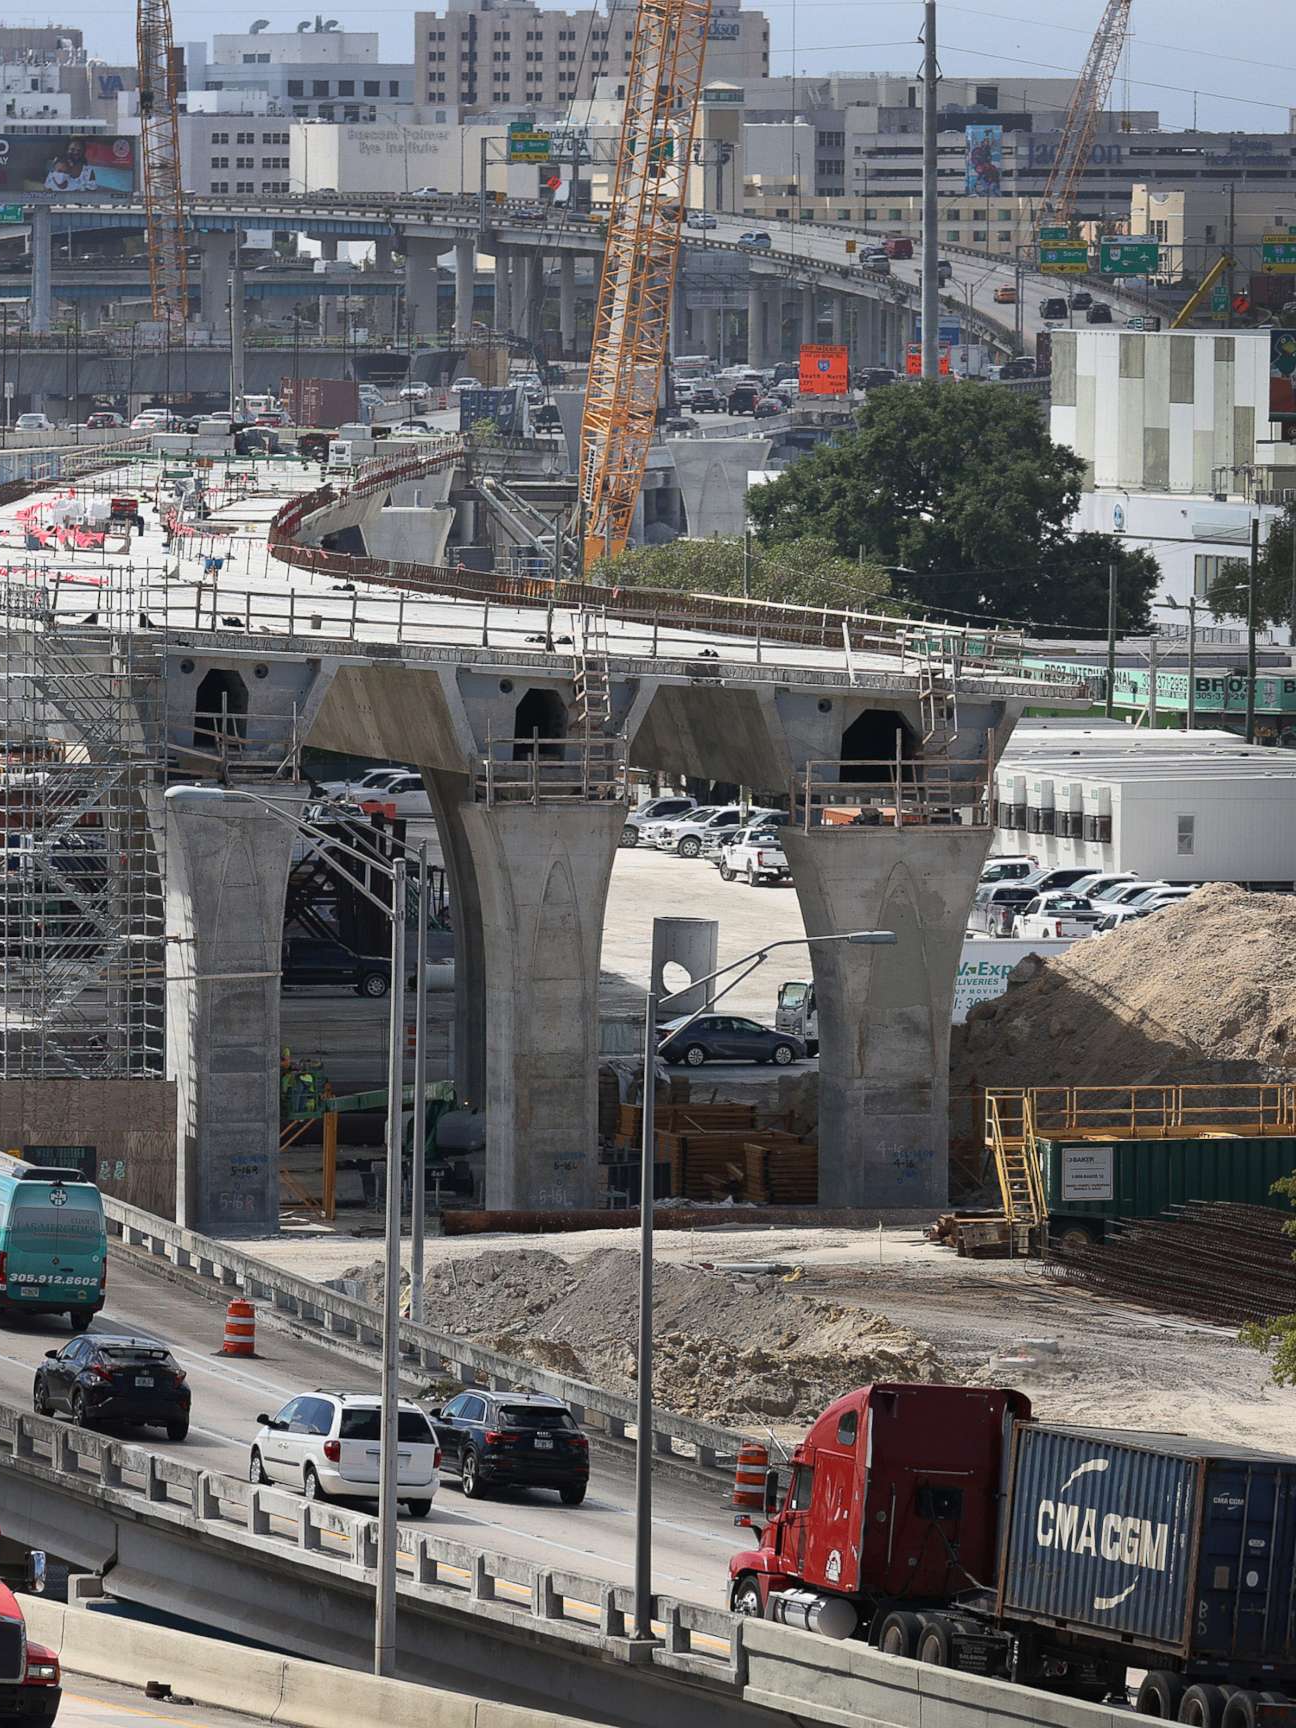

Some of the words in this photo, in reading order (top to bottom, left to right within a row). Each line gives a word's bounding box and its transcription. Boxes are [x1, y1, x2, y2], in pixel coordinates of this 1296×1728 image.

[1028, 138, 1122, 168] Jacon
[1196, 677, 1257, 692] BRO
[8, 1273, 98, 1287] 305.912.8602
[1213, 1496, 1228, 1504] CMA
[1229, 1498, 1245, 1506] CGM
[1037, 1499, 1097, 1557] CMA
[1101, 1513, 1169, 1571] CGM
